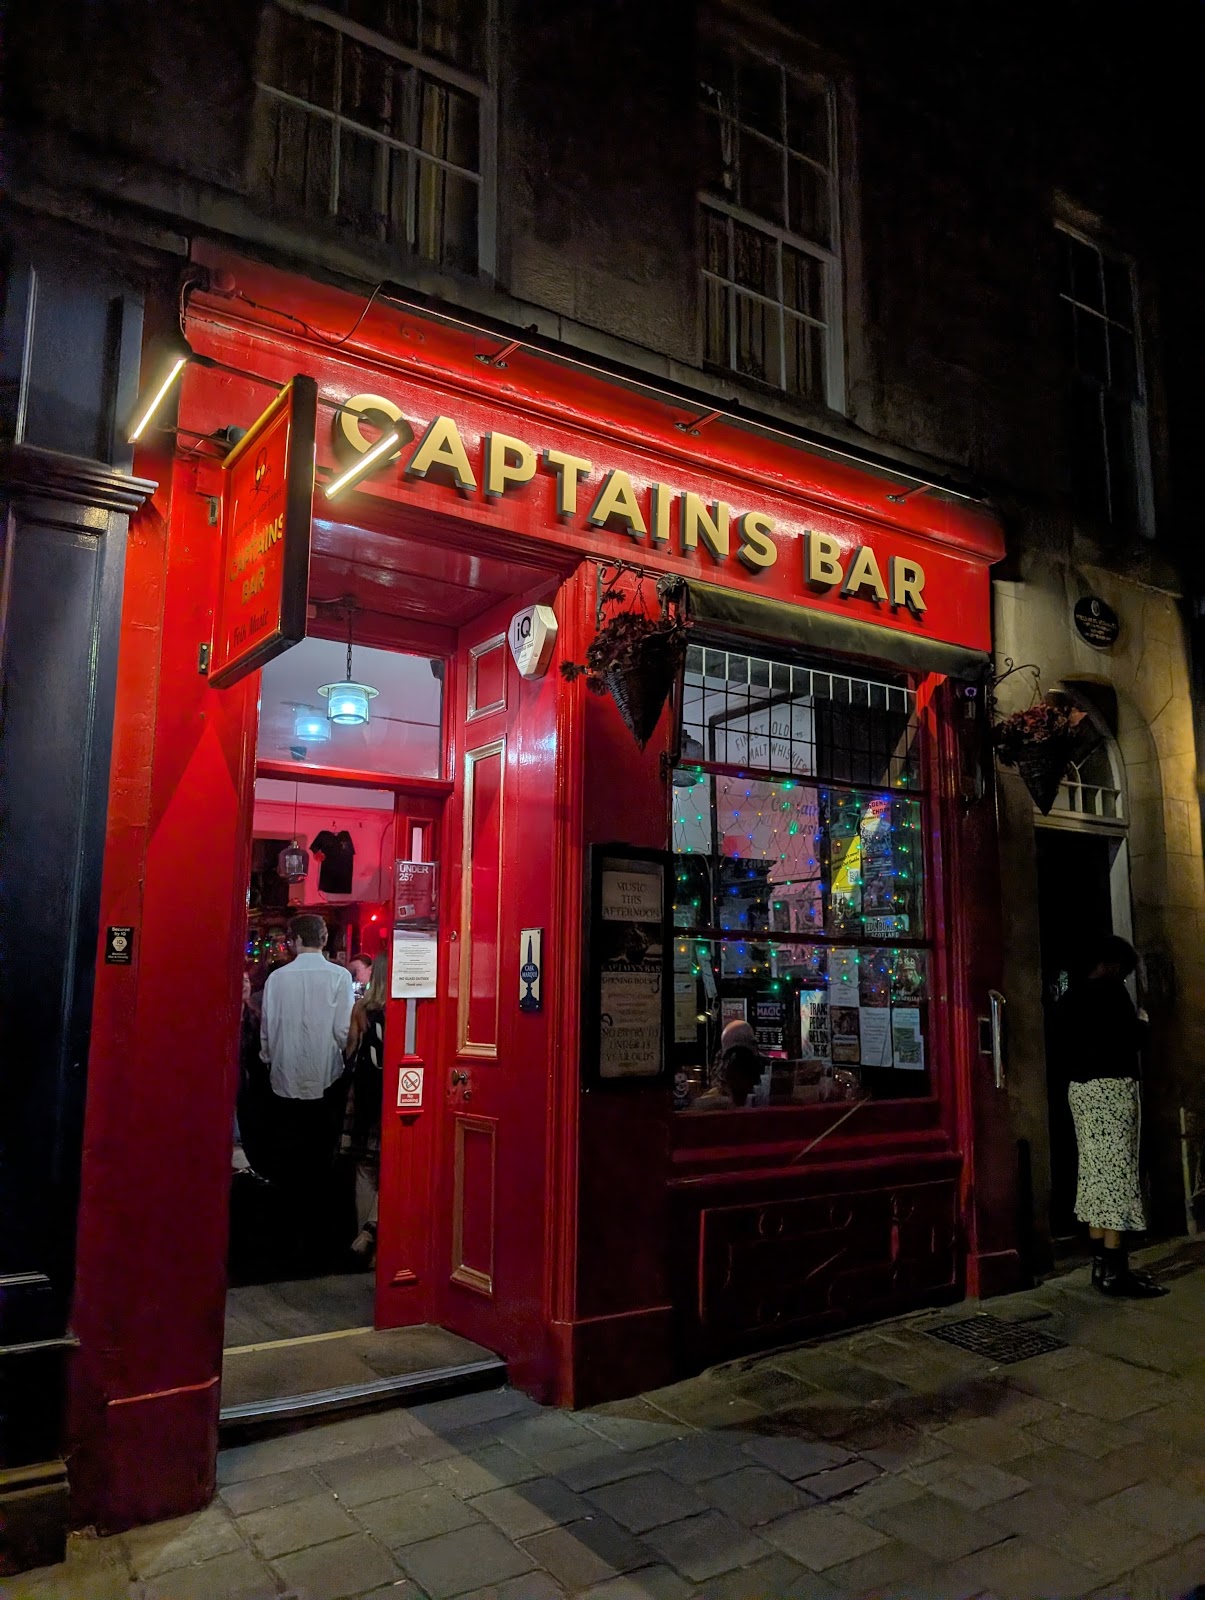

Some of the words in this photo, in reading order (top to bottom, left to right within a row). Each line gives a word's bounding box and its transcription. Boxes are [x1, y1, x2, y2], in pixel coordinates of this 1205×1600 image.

[335, 393, 777, 568] CAPTAINS
[805, 529, 927, 613] BAR
[229, 512, 284, 582] CAPTAINS
[241, 566, 266, 605] BAR
[735, 724, 765, 751] FINEST
[772, 721, 789, 737] OLD
[750, 743, 768, 760] MALT
[771, 742, 807, 770] WHISKIES
[399, 864, 429, 874] UNDER
[398, 873, 414, 882] 25?
[617, 882, 646, 893] MUSIC
[622, 894, 642, 905] THIS
[603, 906, 661, 918] AFTERNOON
[757, 1006, 781, 1017] MAGIC
